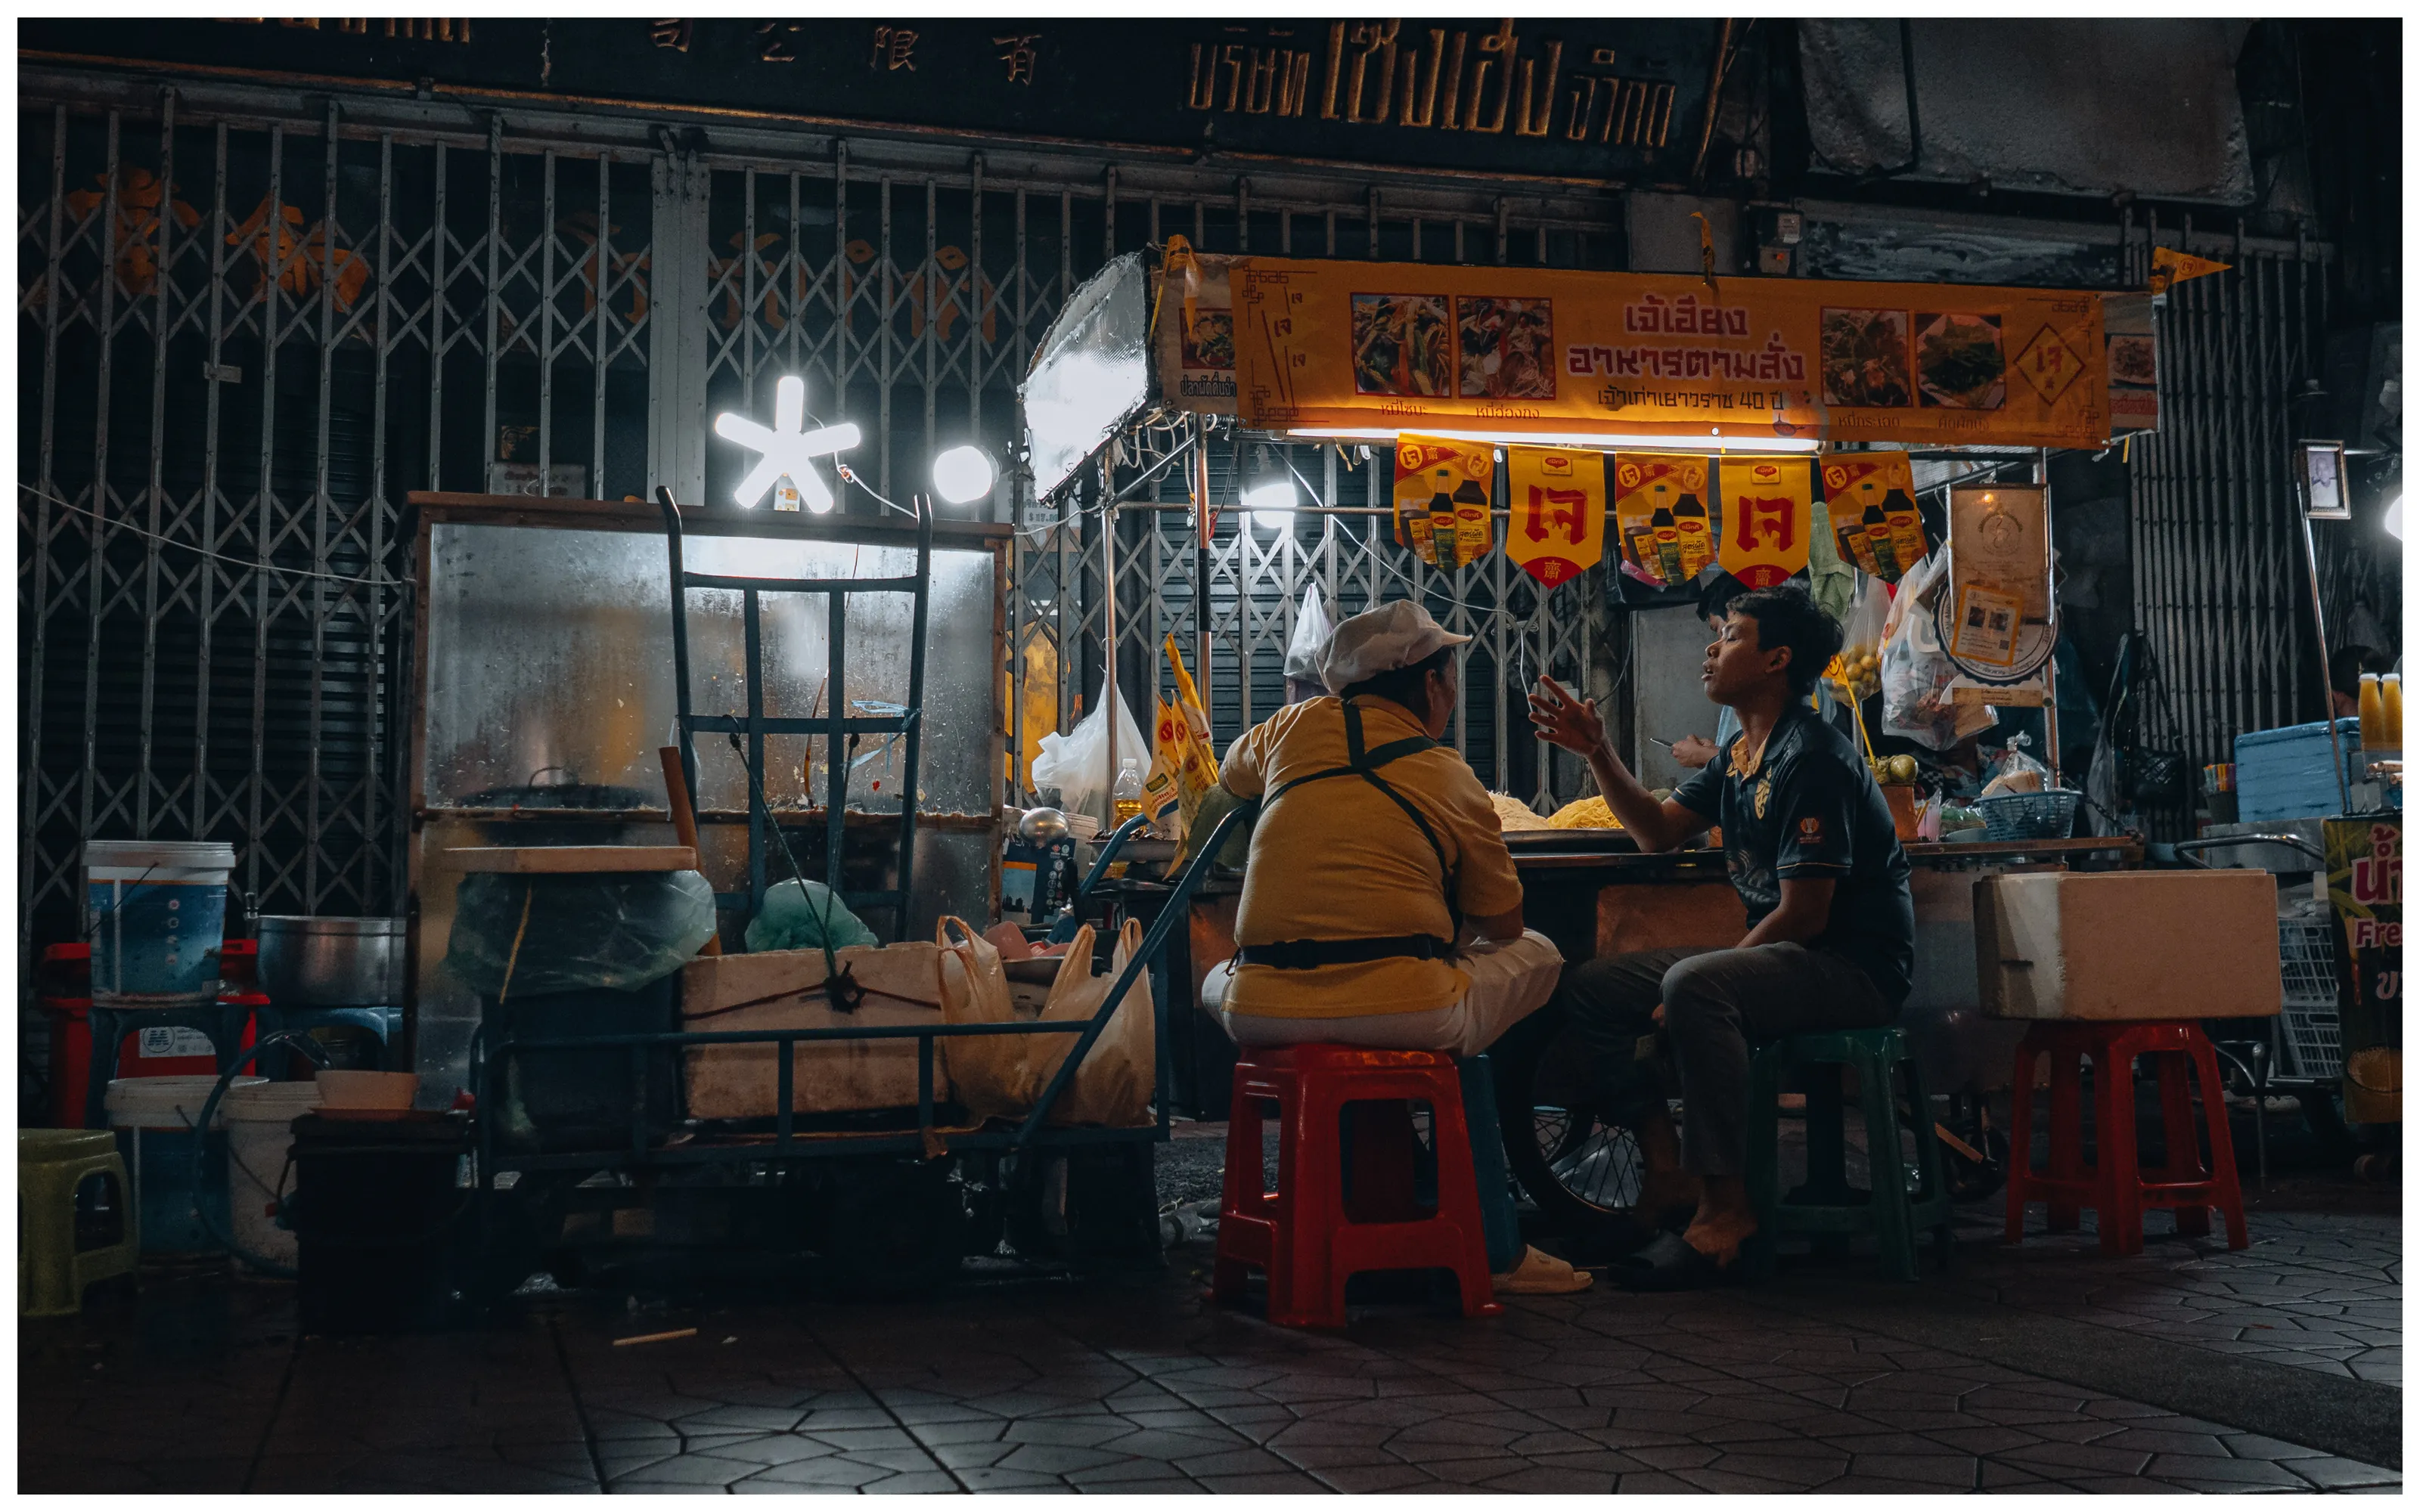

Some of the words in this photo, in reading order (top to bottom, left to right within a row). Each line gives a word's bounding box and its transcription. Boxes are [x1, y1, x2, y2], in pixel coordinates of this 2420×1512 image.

[1569, 332, 1805, 380] อาหารตามสั่ง
[1739, 392, 1765, 410] 40
[1770, 390, 1785, 411] ปี
[1525, 484, 1587, 545] เจ
[1736, 495, 1795, 552] เจ
[2356, 921, 2403, 946] Fre
